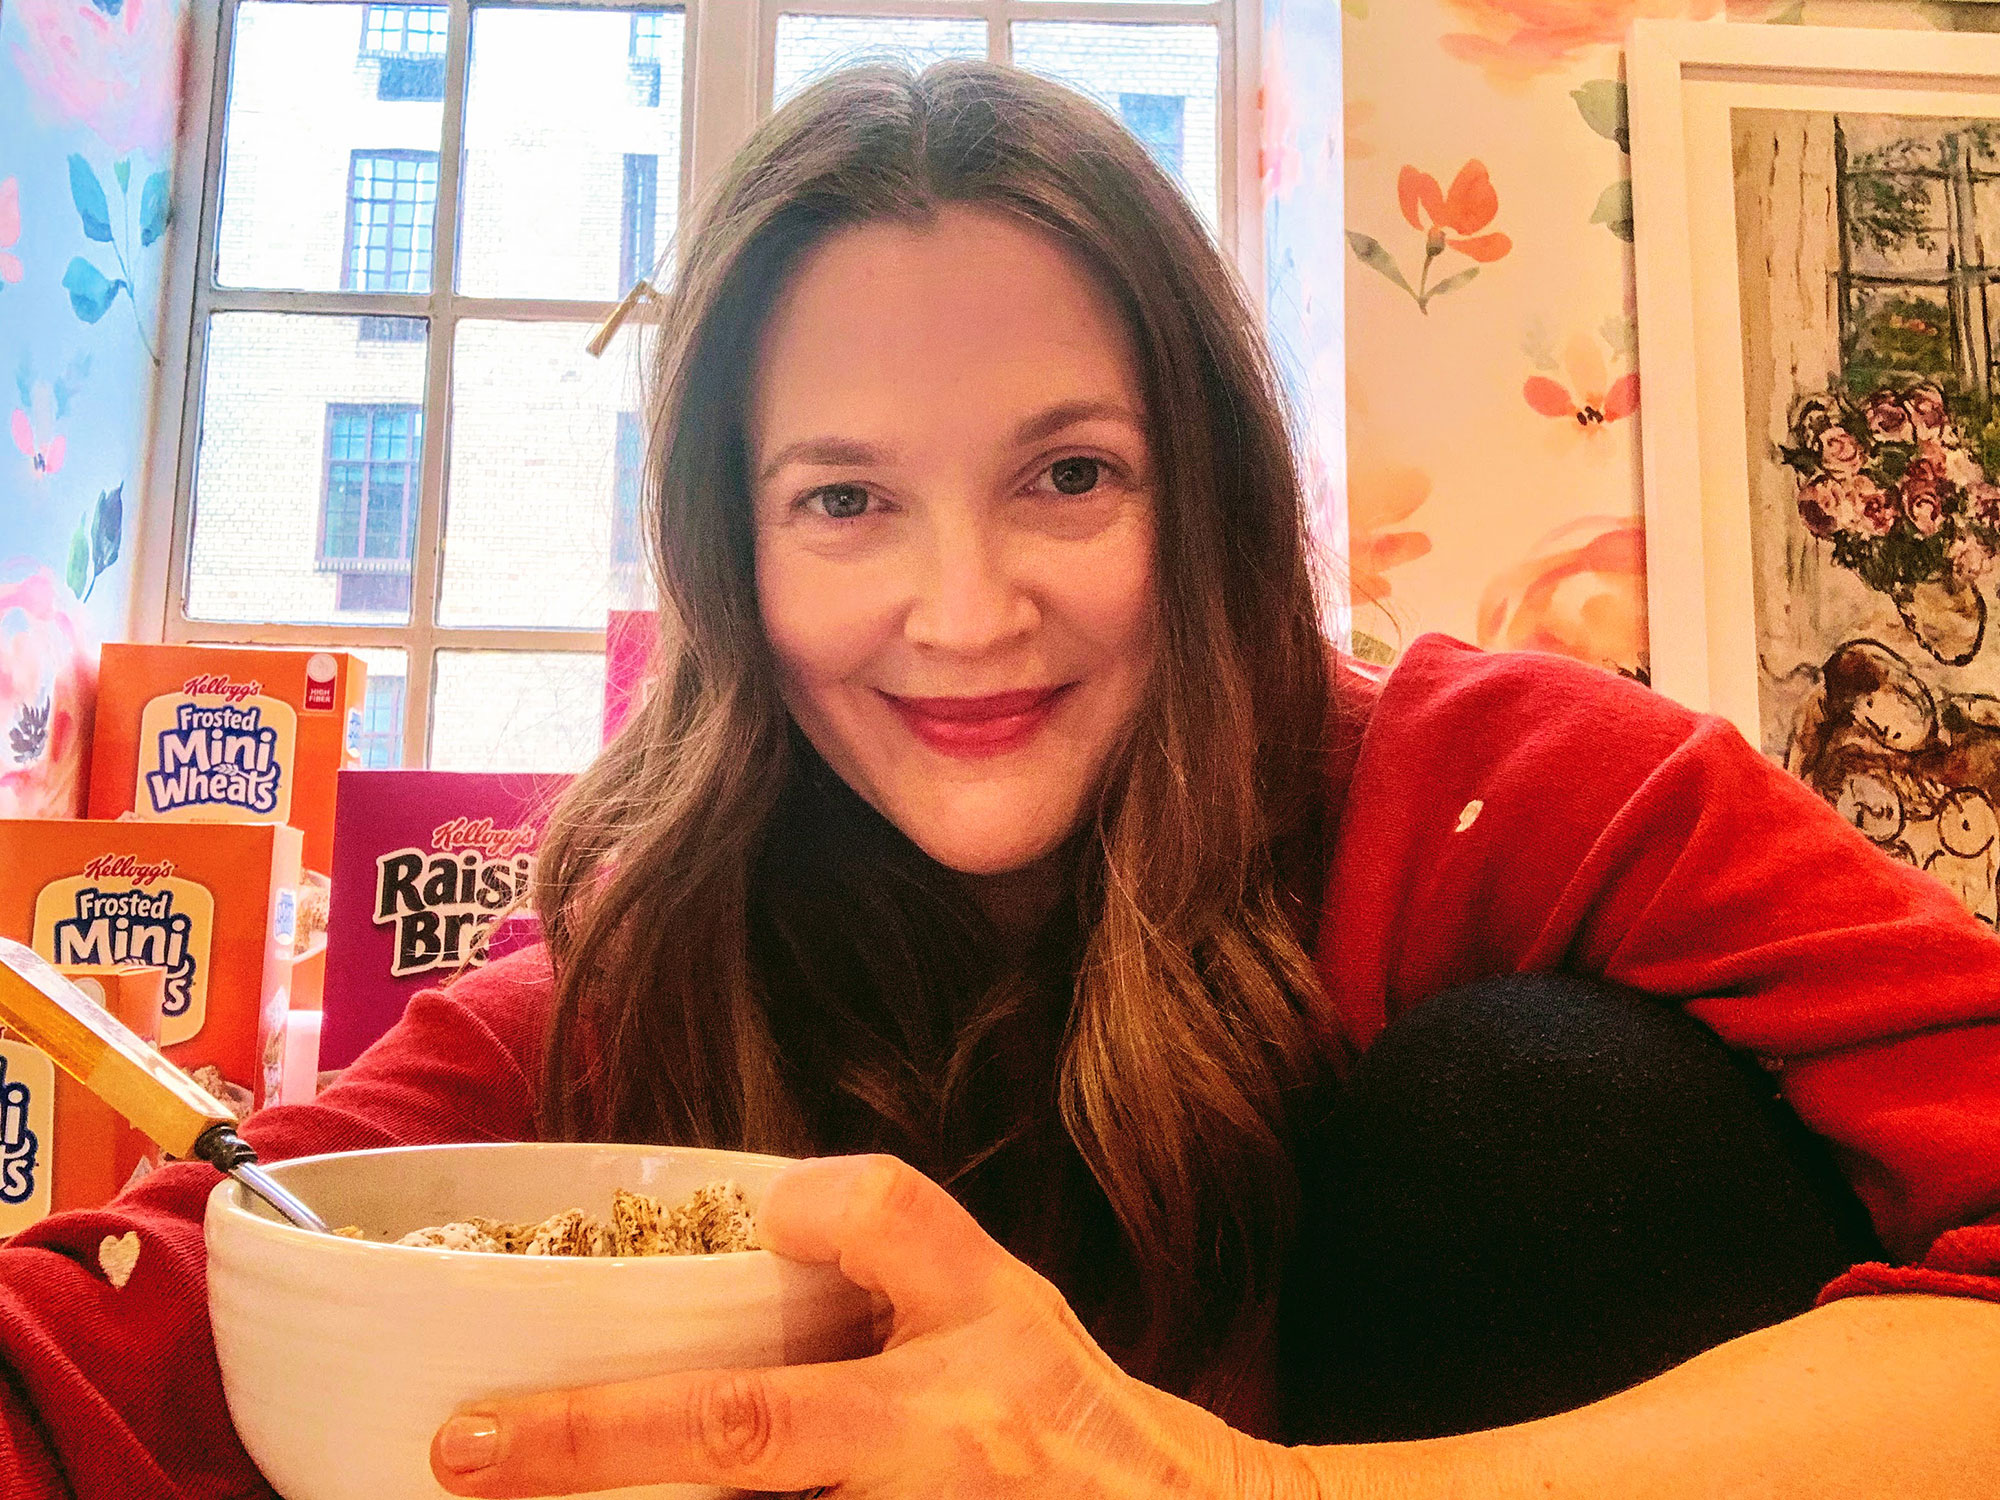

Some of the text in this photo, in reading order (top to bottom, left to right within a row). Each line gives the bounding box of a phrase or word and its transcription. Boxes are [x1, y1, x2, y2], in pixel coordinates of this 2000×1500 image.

[184, 675, 261, 701] Kellogg's
[308, 695, 331, 703] FIBER
[310, 688, 330, 696] HIGH
[180, 707, 257, 731] Frosted
[163, 730, 272, 773] Mini
[150, 766, 276, 809] Wheats
[432, 818, 534, 855] Kellogg's
[84, 854, 173, 885] Kellogg's
[379, 852, 530, 917] Raisi
[80, 893, 169, 920] Frosted
[59, 917, 186, 967] Mini
